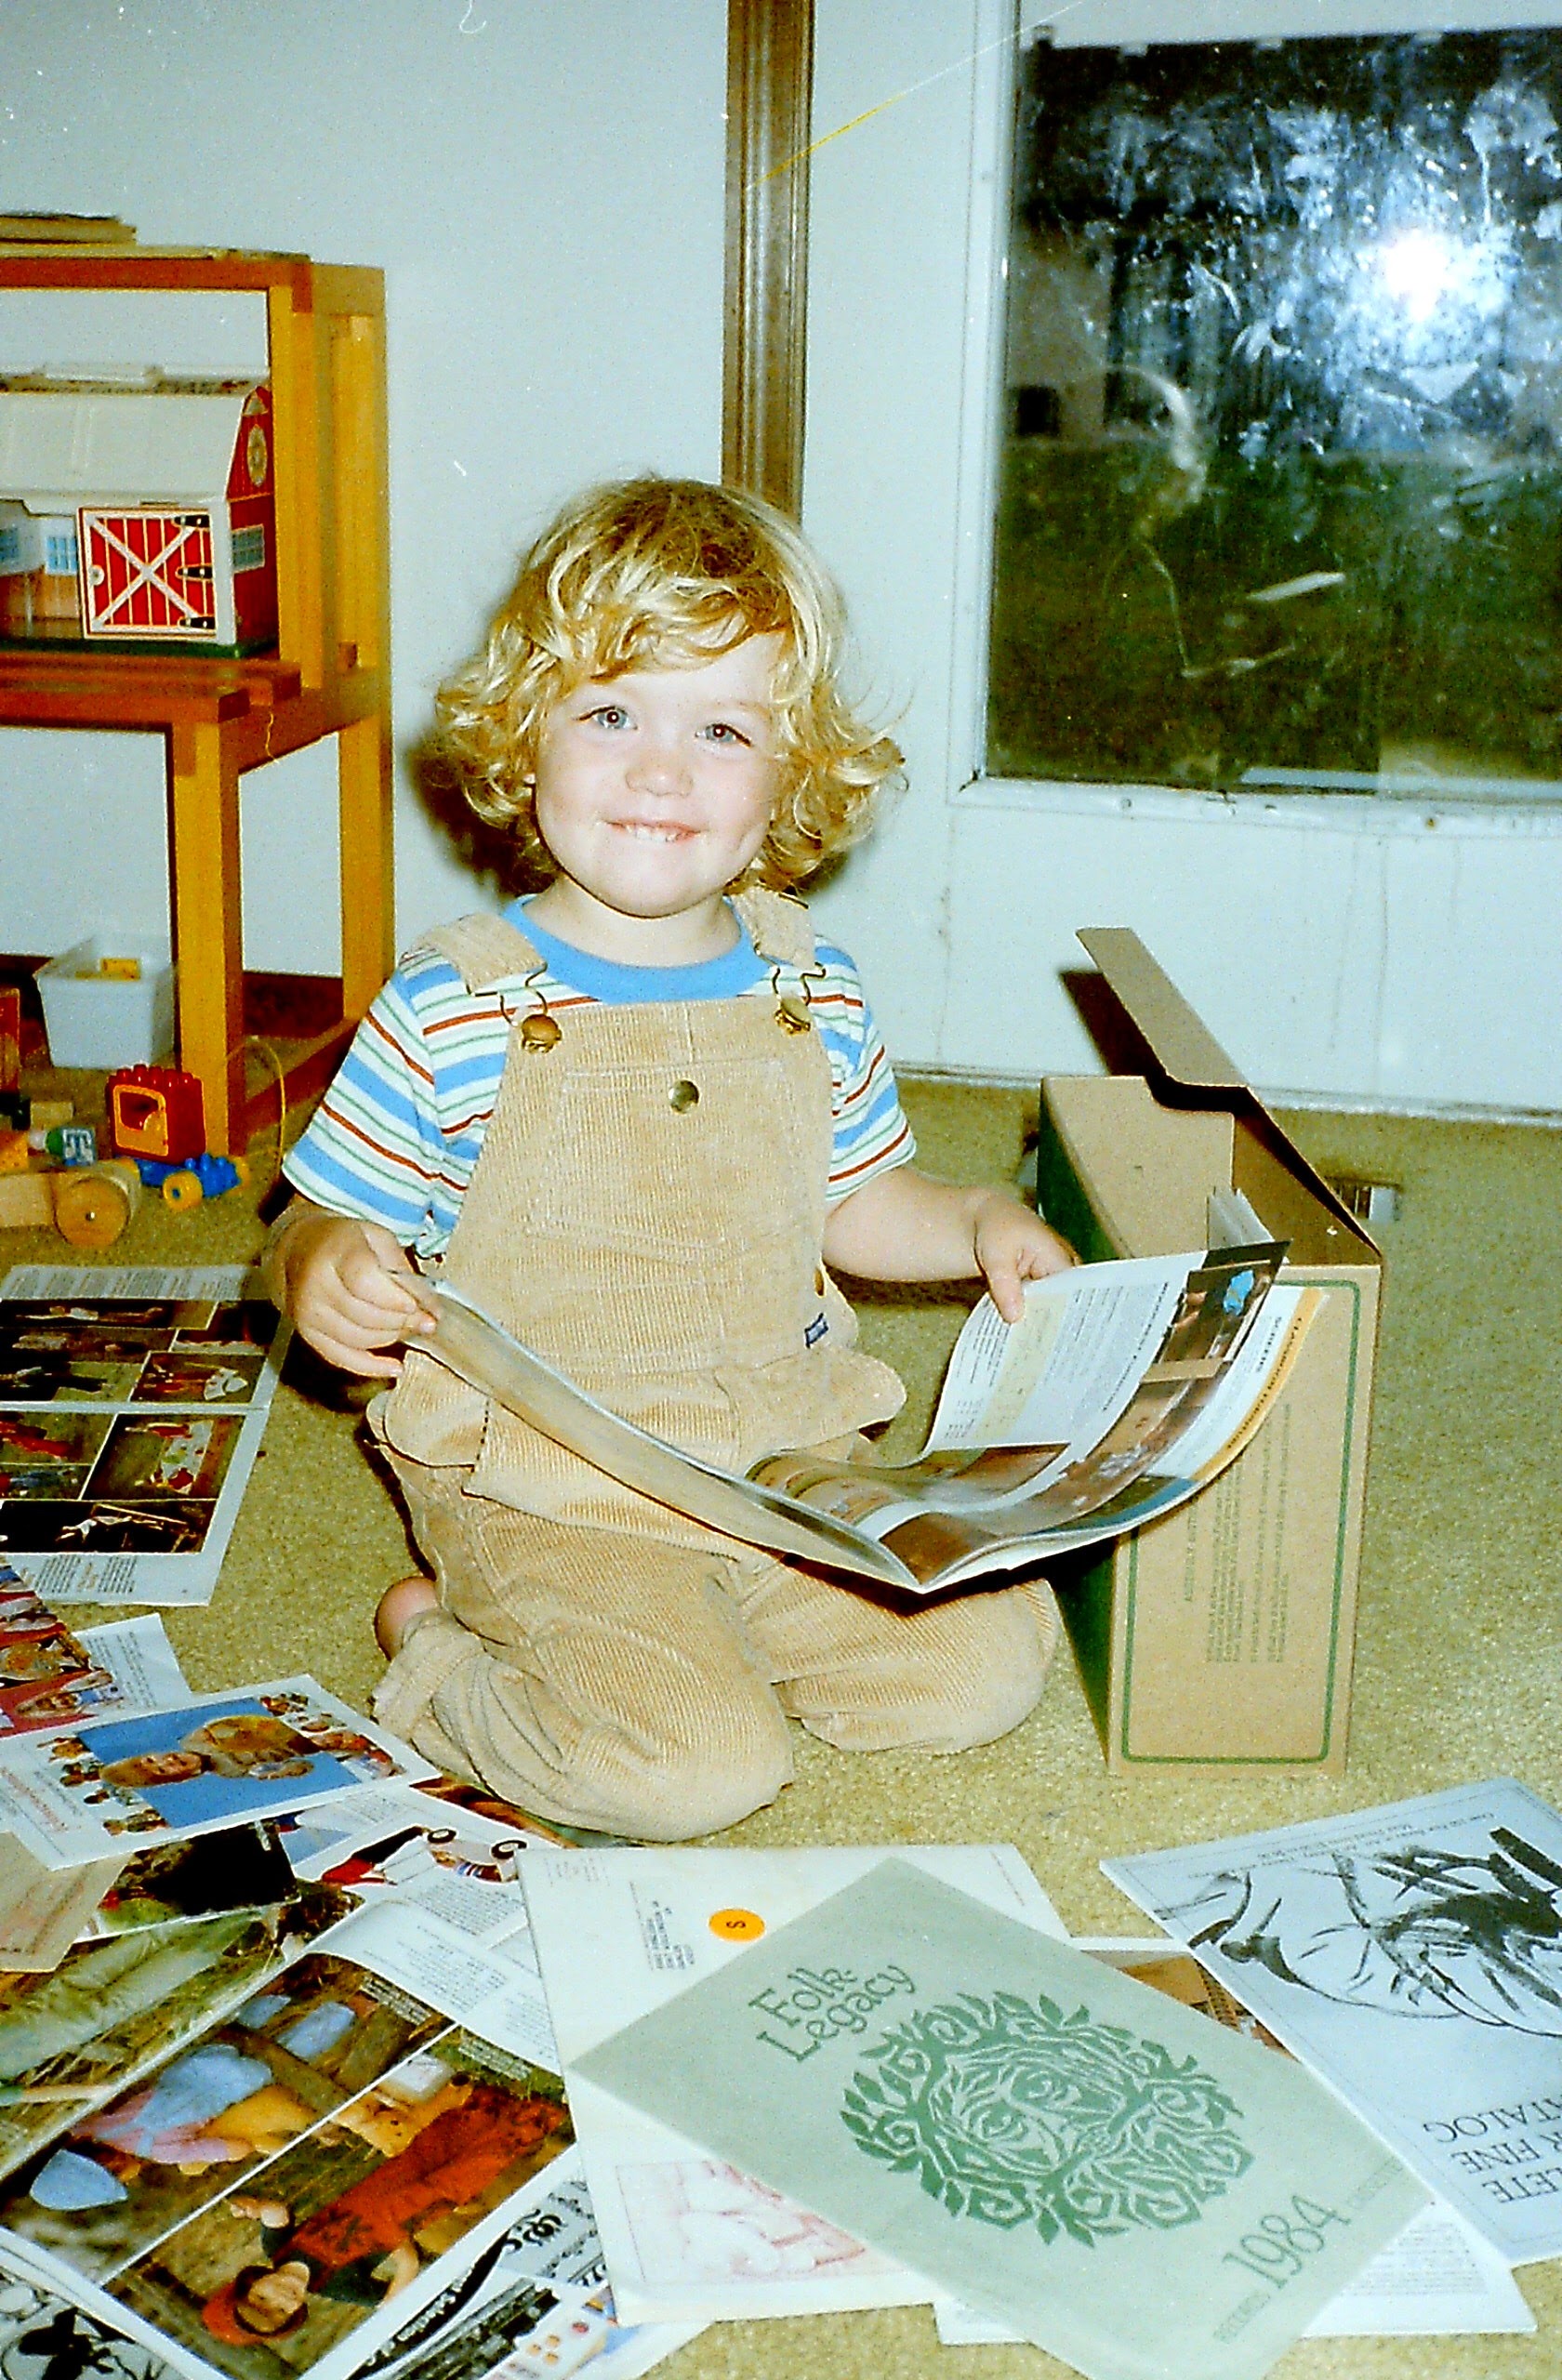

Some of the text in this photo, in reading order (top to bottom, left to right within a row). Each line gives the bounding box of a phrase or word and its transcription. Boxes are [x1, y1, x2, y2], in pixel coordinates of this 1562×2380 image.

[755, 1964, 917, 2063] Legacy
[1449, 2138, 1541, 2175] FINE
[1221, 2194, 1352, 2290] 1984
